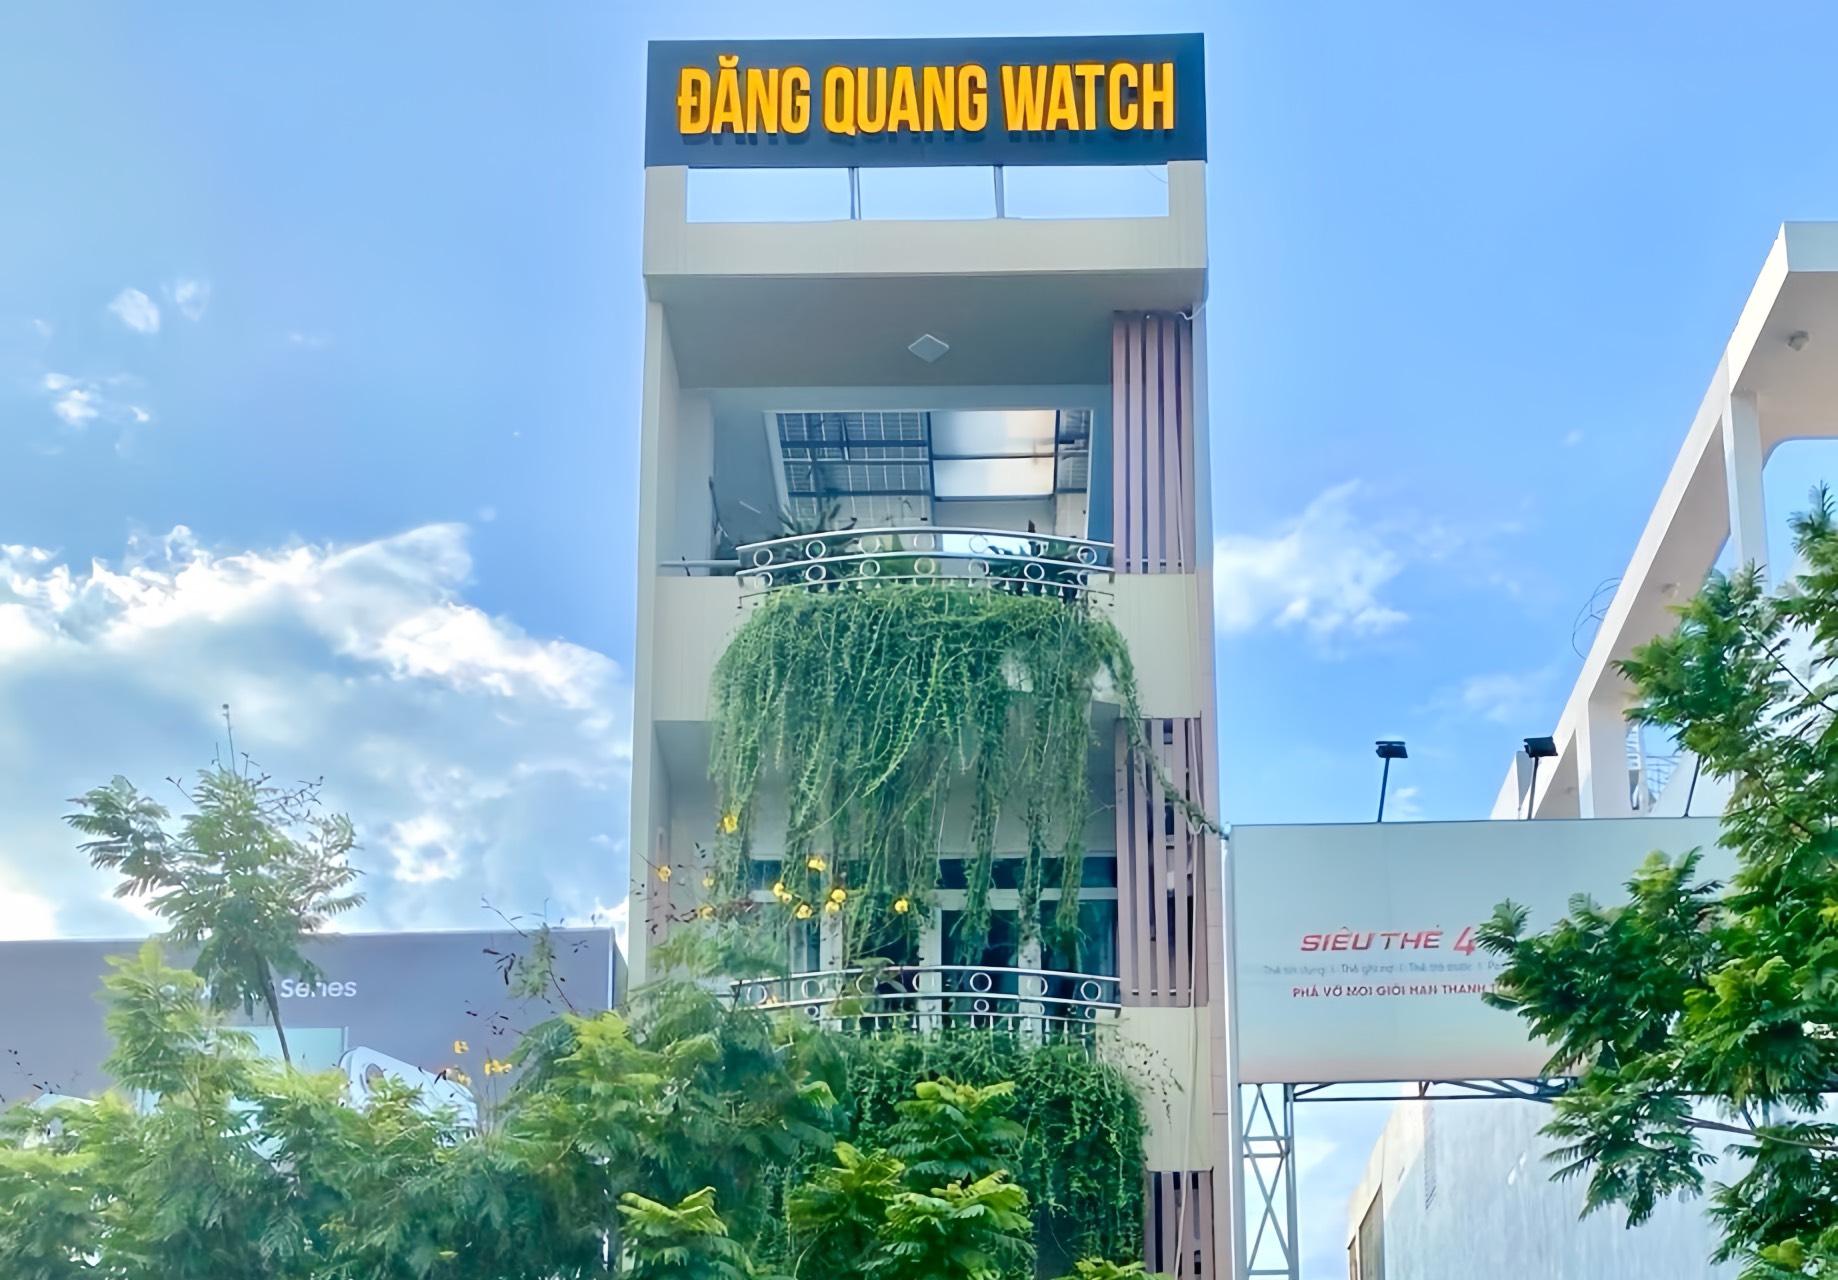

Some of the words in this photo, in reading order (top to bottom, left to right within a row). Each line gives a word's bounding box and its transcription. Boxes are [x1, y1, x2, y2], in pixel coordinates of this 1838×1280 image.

[677, 55, 811, 134] ĐĂNG
[823, 63, 988, 136] QUANG
[1001, 62, 1175, 132] WATCH
[1300, 926, 1376, 952] SIÊU
